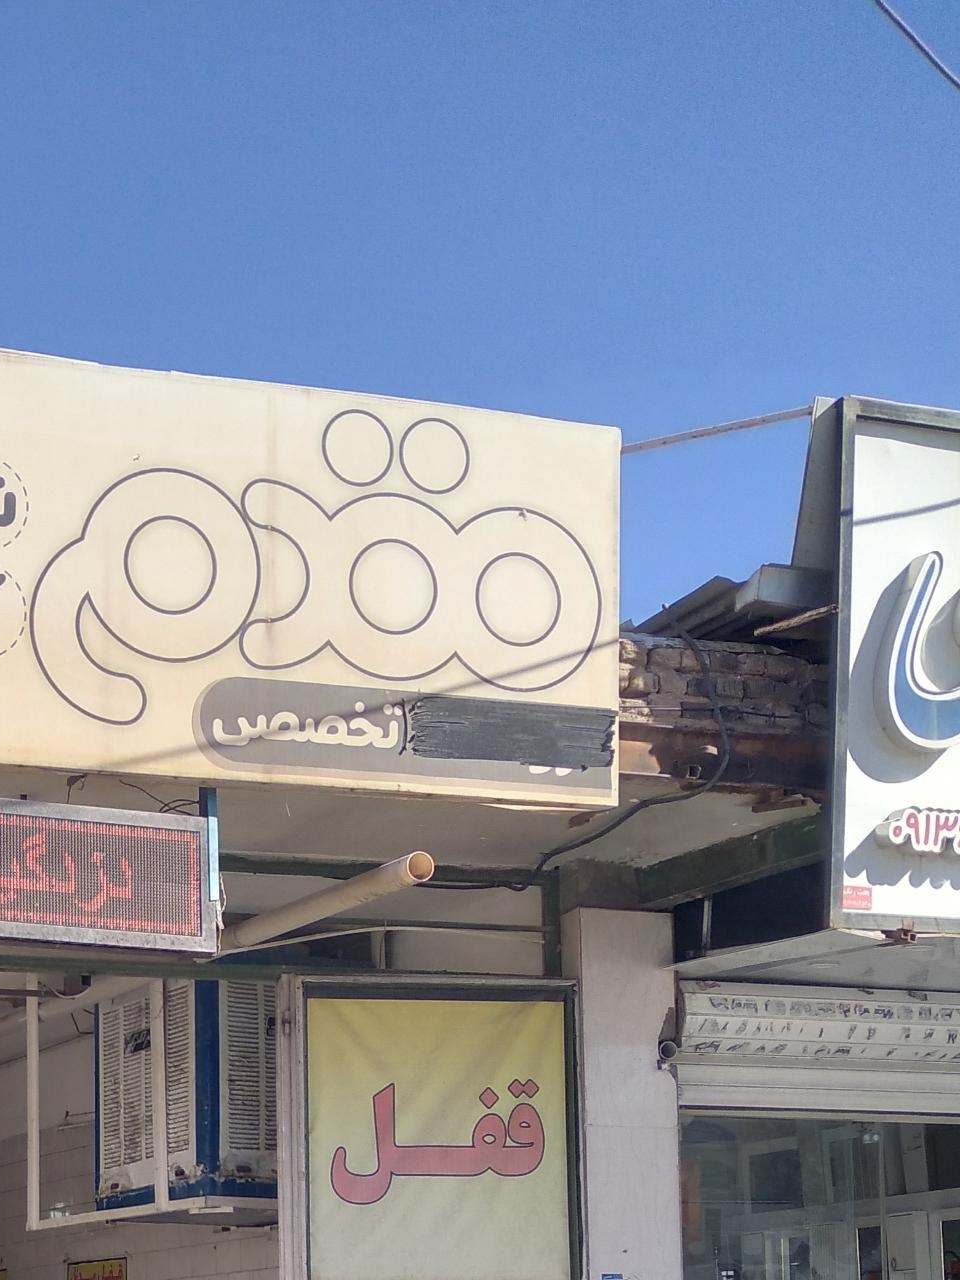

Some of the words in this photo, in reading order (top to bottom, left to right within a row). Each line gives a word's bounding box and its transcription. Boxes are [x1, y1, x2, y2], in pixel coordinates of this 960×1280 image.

[29, 408, 602, 726] مقدم
[213, 700, 404, 749] تخصصی
[892, 811, 960, 852] ۰۹۱۳
[330, 1078, 545, 1205] قفل
